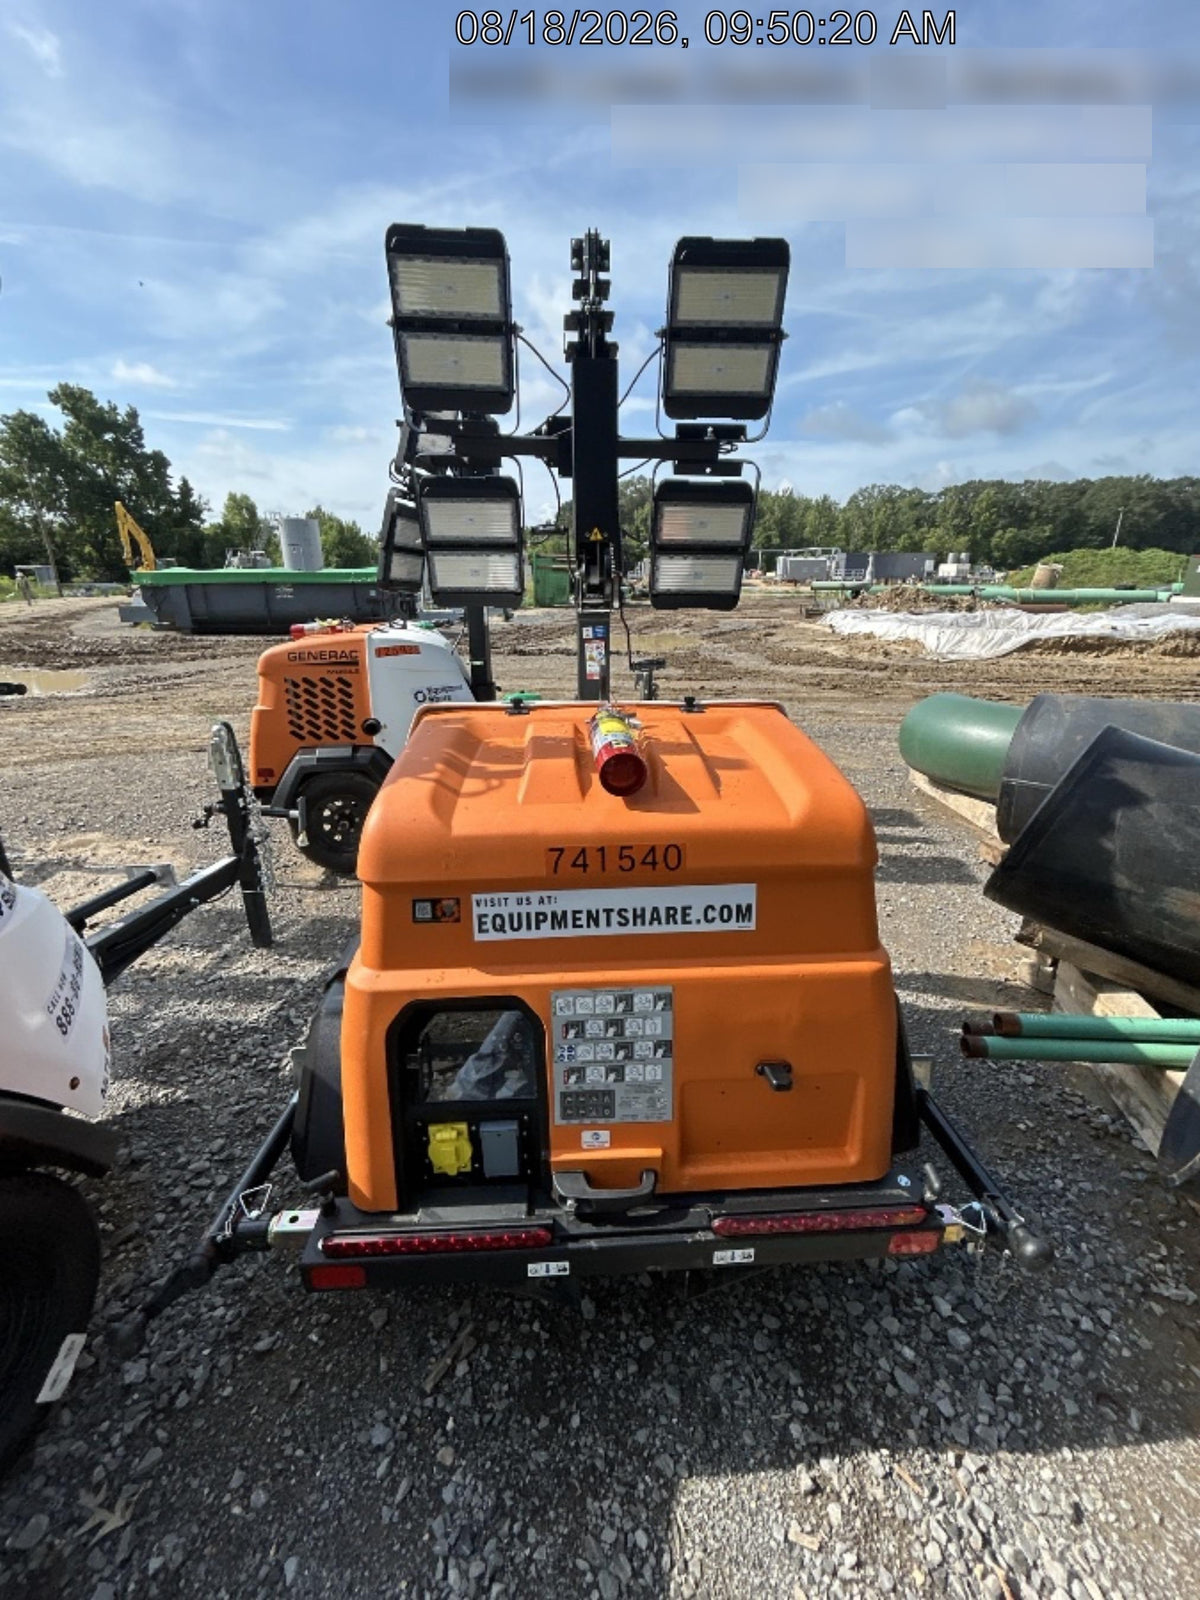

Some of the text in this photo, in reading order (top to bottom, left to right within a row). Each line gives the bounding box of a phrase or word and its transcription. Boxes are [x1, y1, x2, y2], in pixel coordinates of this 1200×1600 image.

[288, 650, 359, 661] GENERAC
[548, 844, 682, 874] 741540
[475, 895, 558, 908] VISIT US AT:
[477, 903, 753, 934] EQUIPMENTSHARE.COM
